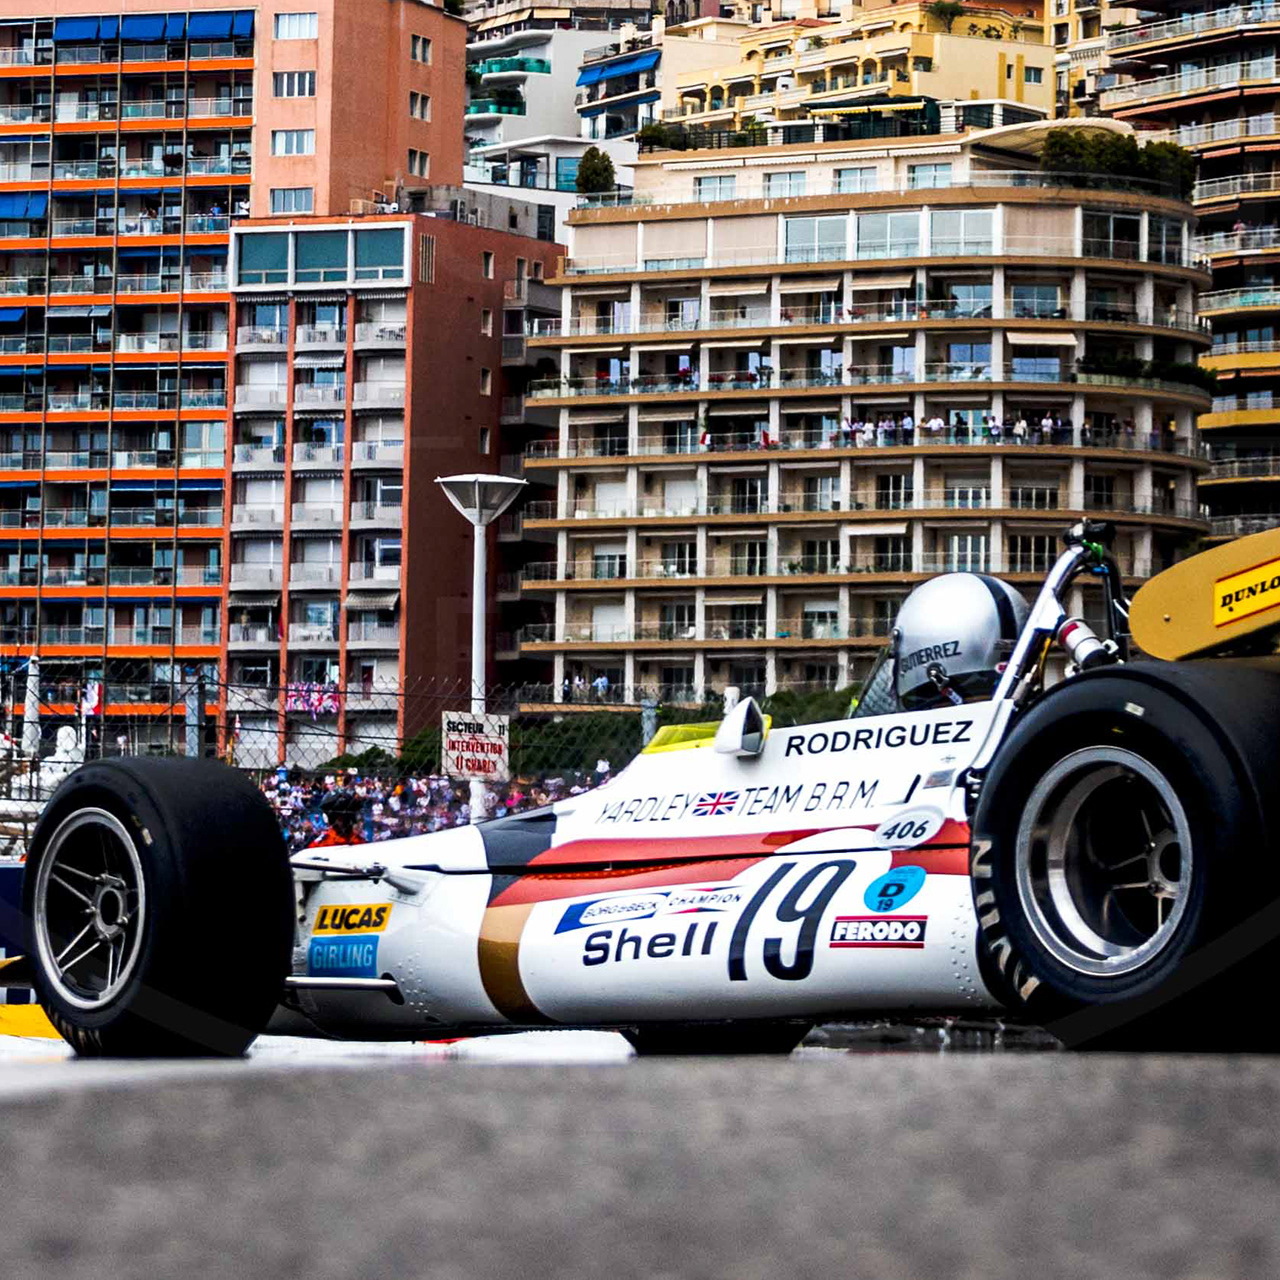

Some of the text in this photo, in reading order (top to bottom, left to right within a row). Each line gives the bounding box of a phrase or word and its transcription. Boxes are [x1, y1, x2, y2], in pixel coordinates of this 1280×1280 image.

[900, 640, 962, 673] GUTIERREZ
[446, 720, 485, 734] SECTEUR
[448, 739, 503, 755] INTERVENTION
[785, 720, 974, 757] RODRIGUEZ
[595, 779, 880, 824] YARDLEY TEAM B.R.M.
[881, 819, 930, 840] 406
[668, 893, 743, 907] CHAMPION
[877, 882, 906, 898] D
[876, 898, 894, 912] 19
[317, 907, 388, 930] LUCAS
[727, 859, 858, 981] 19
[833, 921, 922, 941] FERODO
[582, 921, 719, 967] Shell
[312, 943, 374, 969] GIRLING
